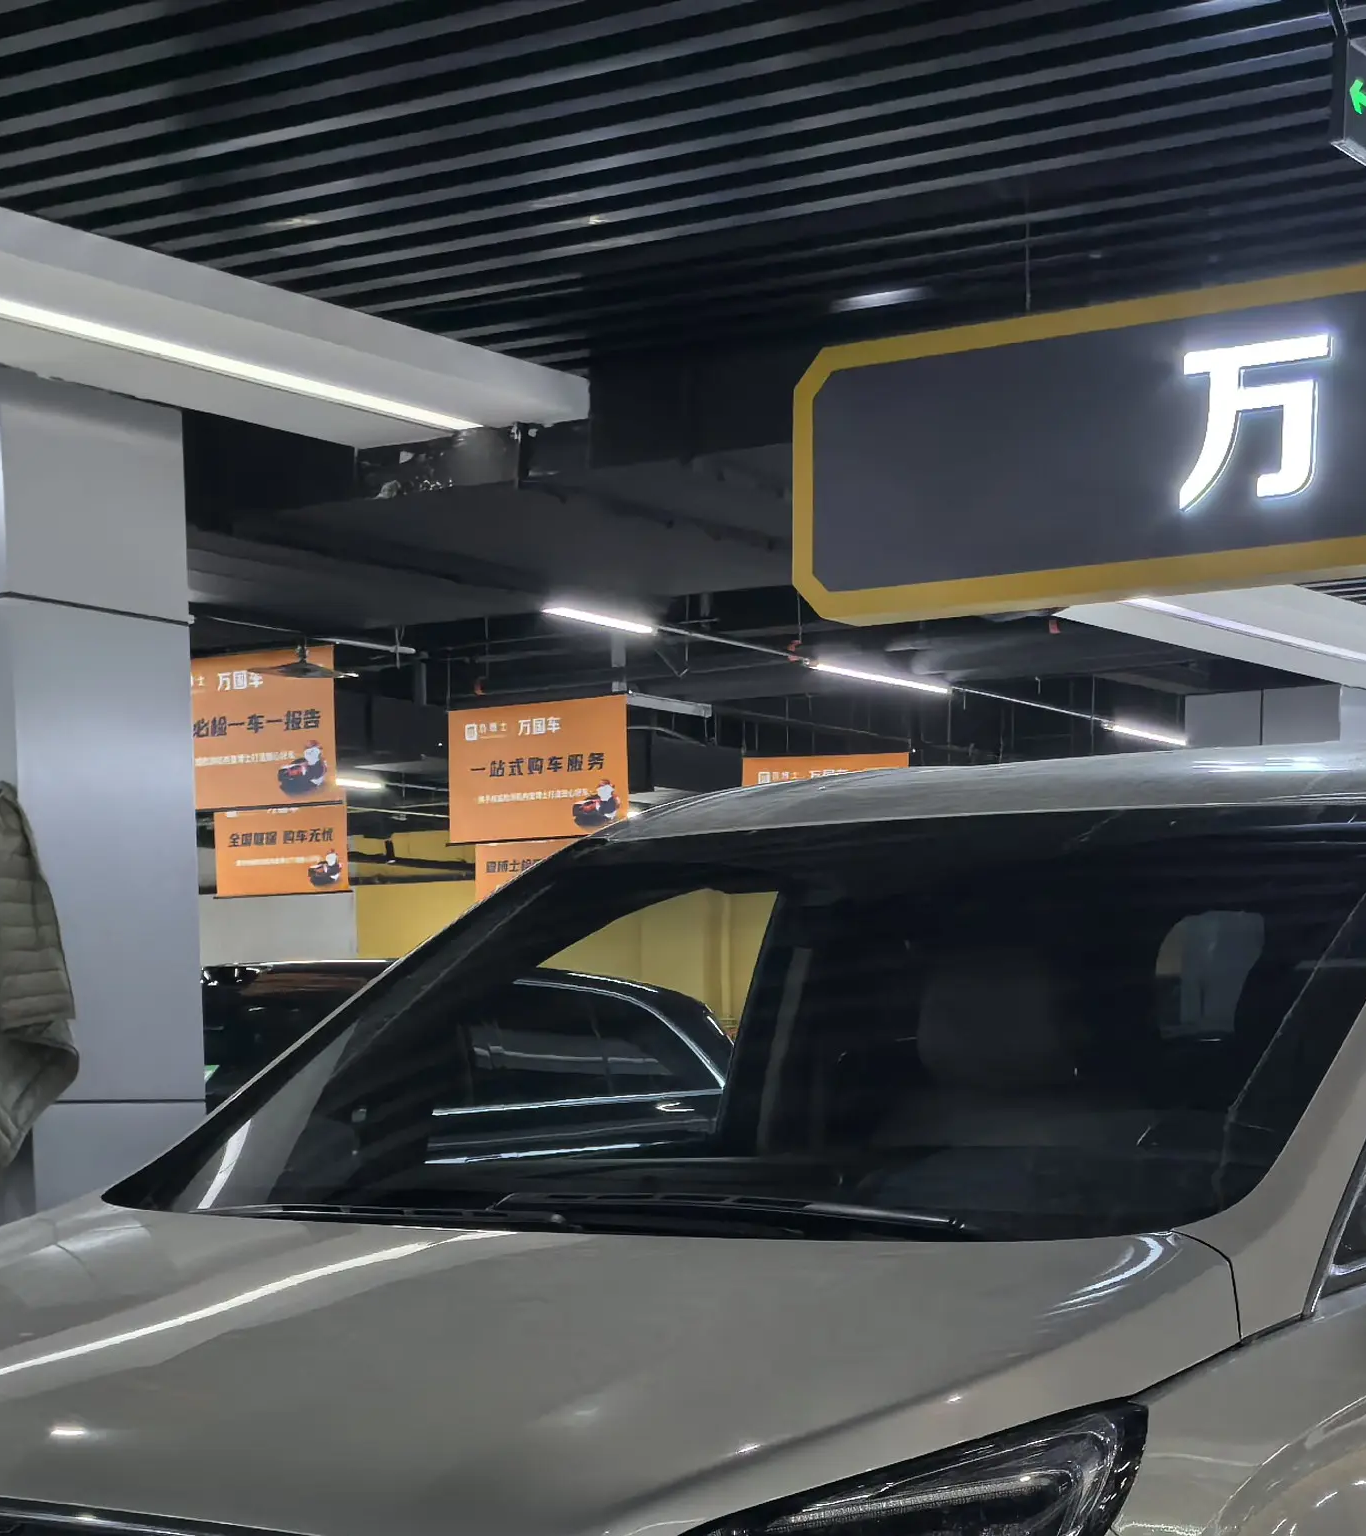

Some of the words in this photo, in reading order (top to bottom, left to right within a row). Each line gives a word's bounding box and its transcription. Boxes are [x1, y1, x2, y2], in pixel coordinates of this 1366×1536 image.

[518, 716, 561, 736] 万国车
[470, 752, 605, 777] 一站式购车服务
